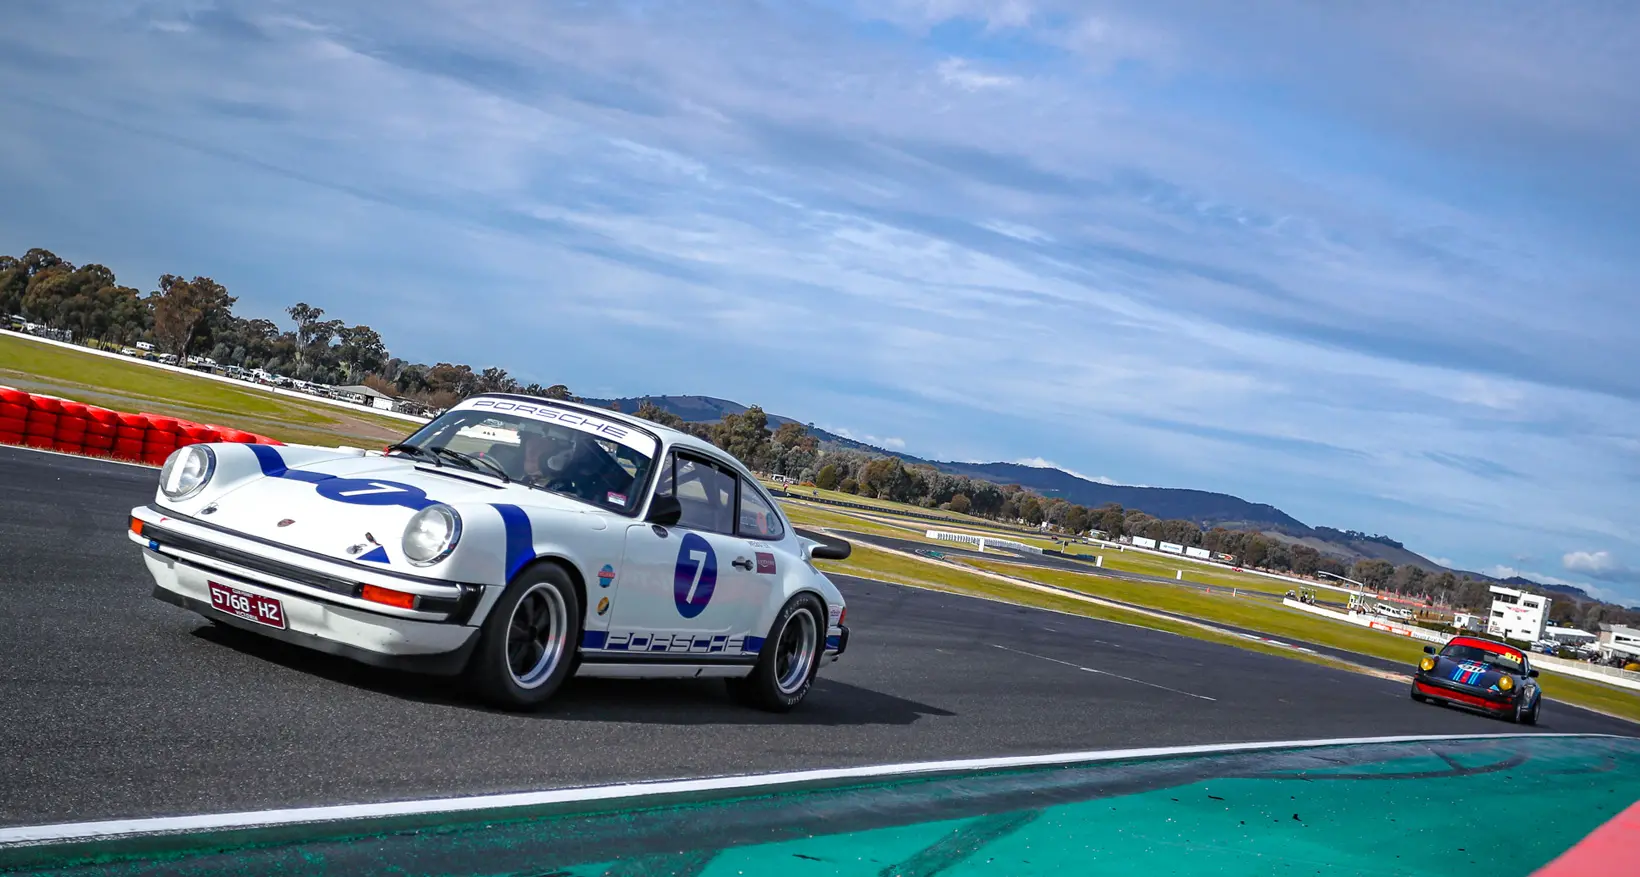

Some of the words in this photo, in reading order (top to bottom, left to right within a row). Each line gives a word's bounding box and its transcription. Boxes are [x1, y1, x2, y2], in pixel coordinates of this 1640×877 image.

[472, 400, 629, 439] PORSCHE
[338, 482, 409, 496] 7
[686, 549, 707, 604] 7
[211, 587, 280, 621] 5768-H2
[603, 631, 745, 652] PORSCHE
